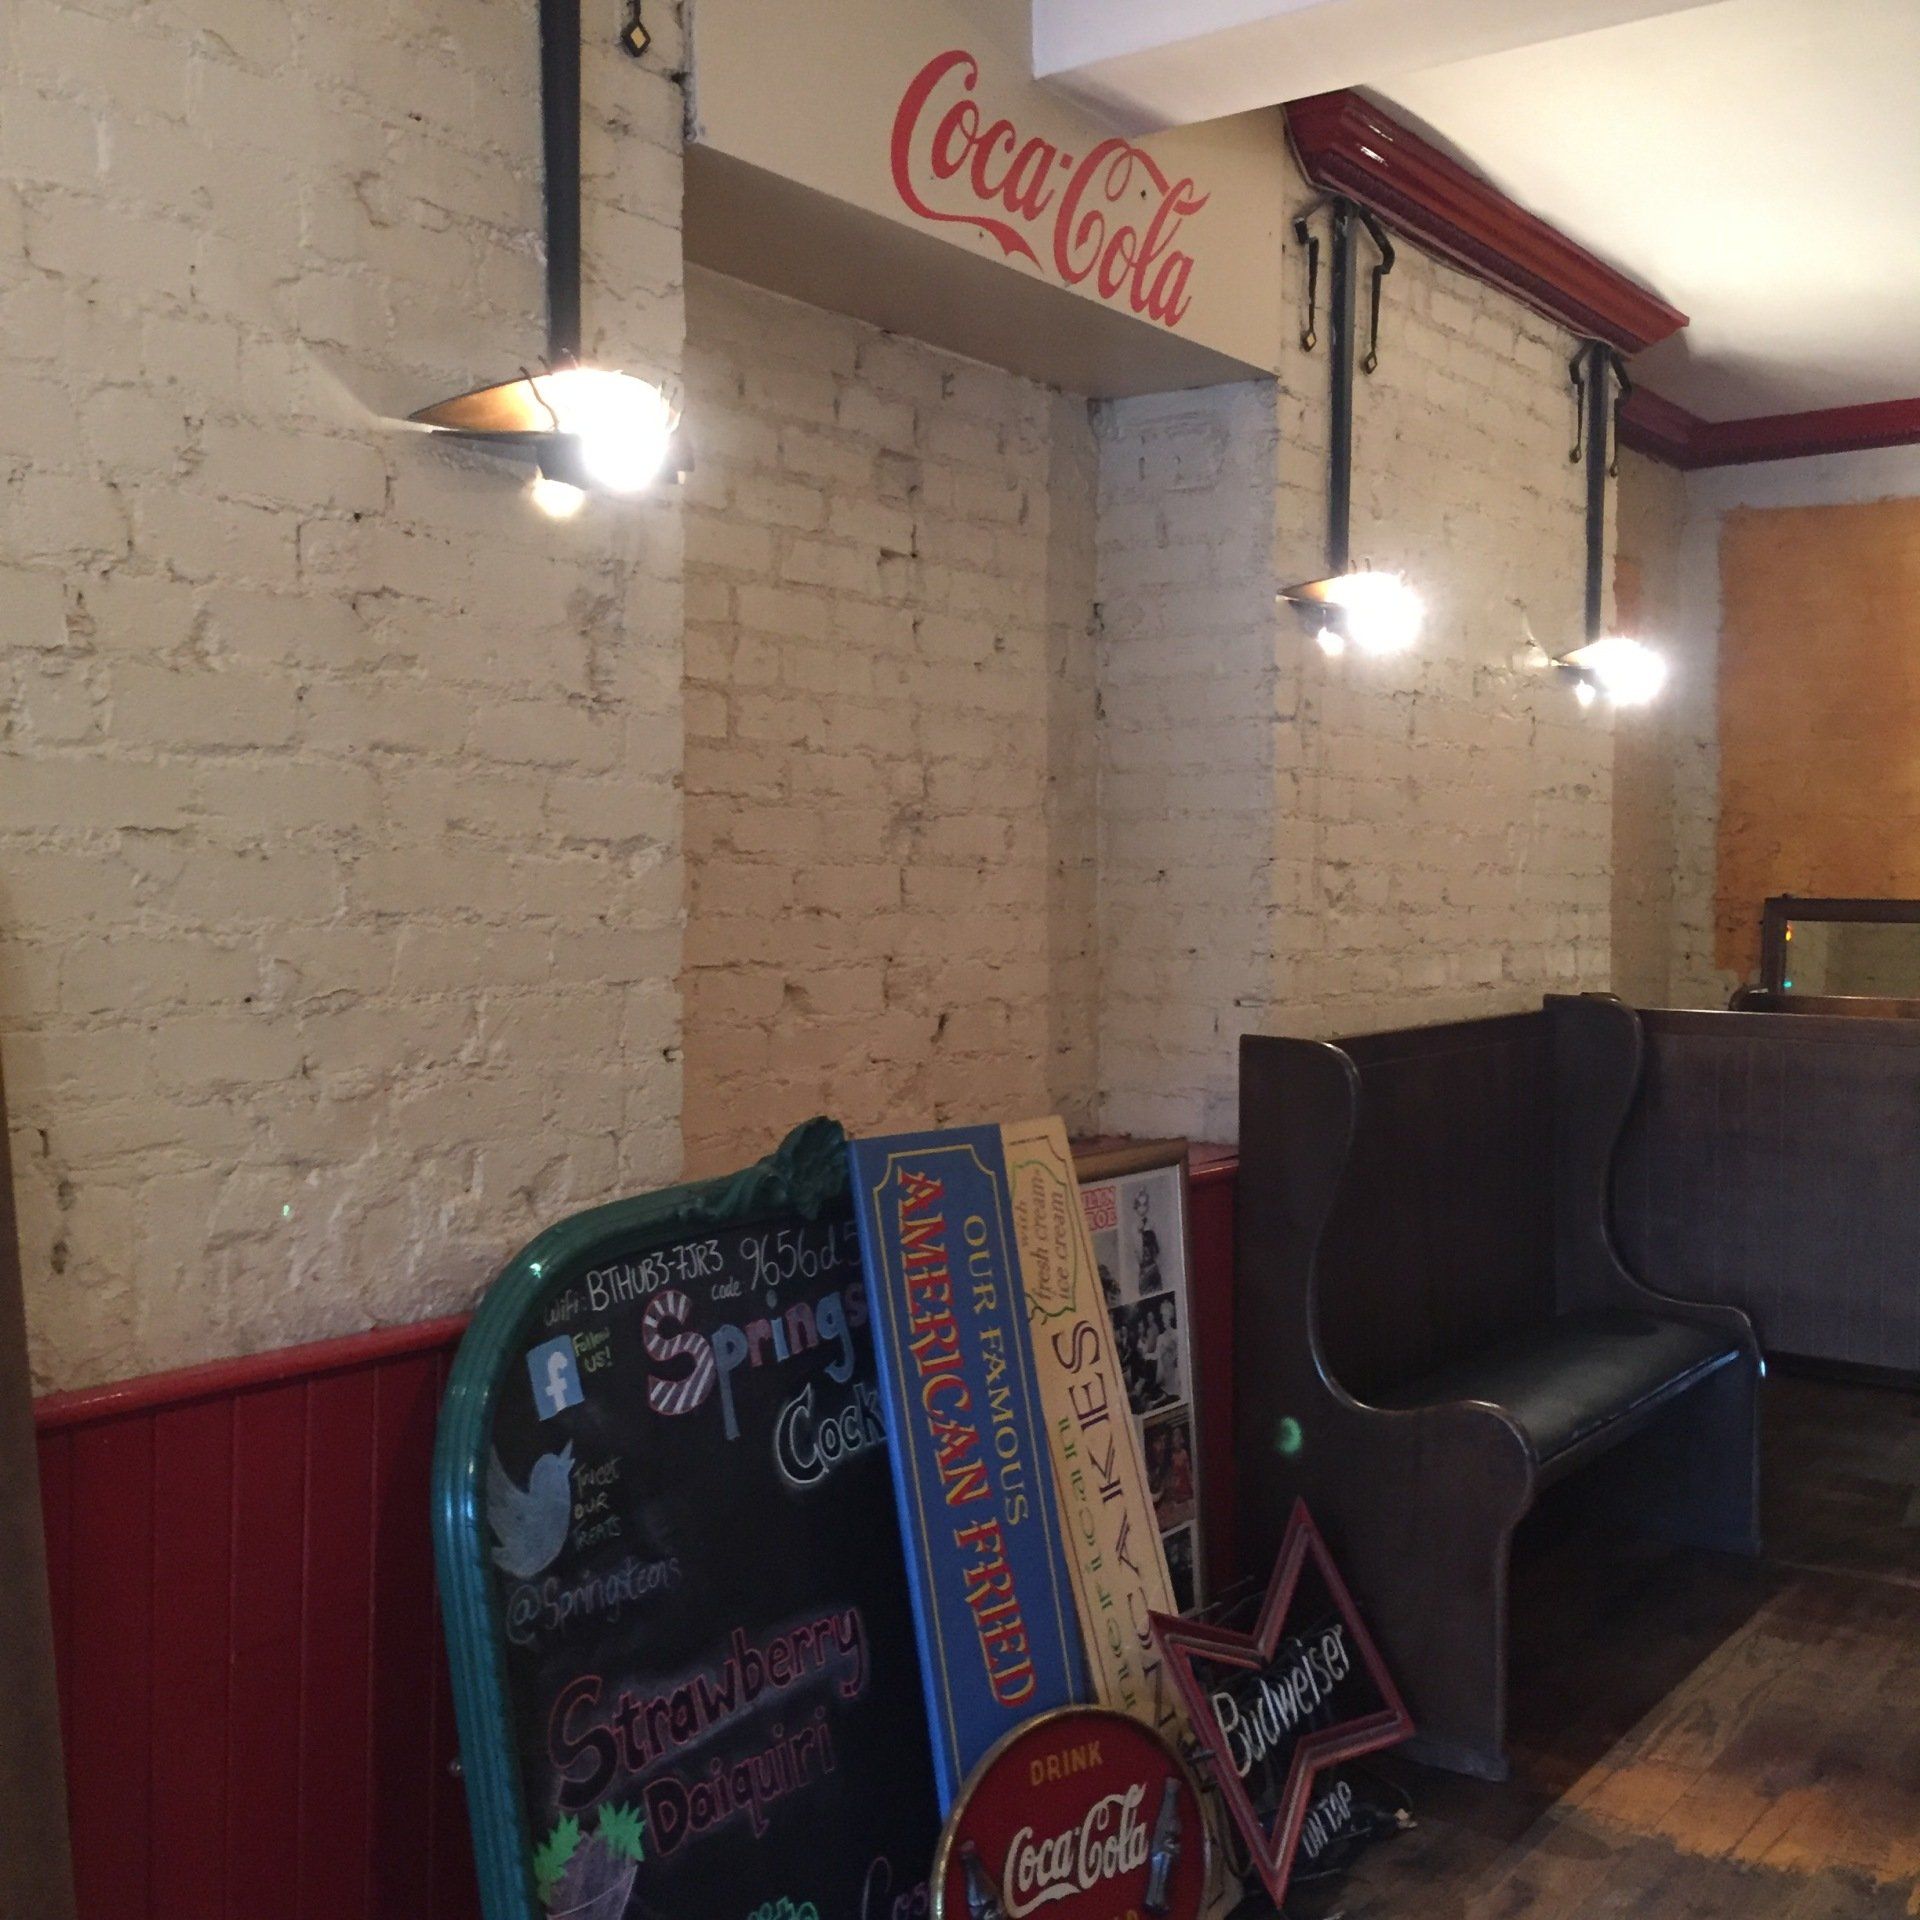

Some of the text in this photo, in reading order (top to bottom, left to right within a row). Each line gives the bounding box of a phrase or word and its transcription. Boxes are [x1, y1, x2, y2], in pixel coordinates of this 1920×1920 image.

[711, 1277, 743, 1301] code
[1030, 1247, 1055, 1301] fresh
[1051, 1191, 1070, 1300] ice cream
[898, 1165, 1038, 1708] AMERICAN FRIED
[964, 1215, 1029, 1526] OUR FAMOUS
[1053, 1320, 1176, 1728] NCAKES
[1057, 1415, 1135, 1708] merican
[548, 1606, 868, 1810] Strawberry
[1030, 1740, 1104, 1787] DRINK
[1211, 1623, 1351, 1778] Budweiser
[643, 1705, 836, 1858] Daiquiri
